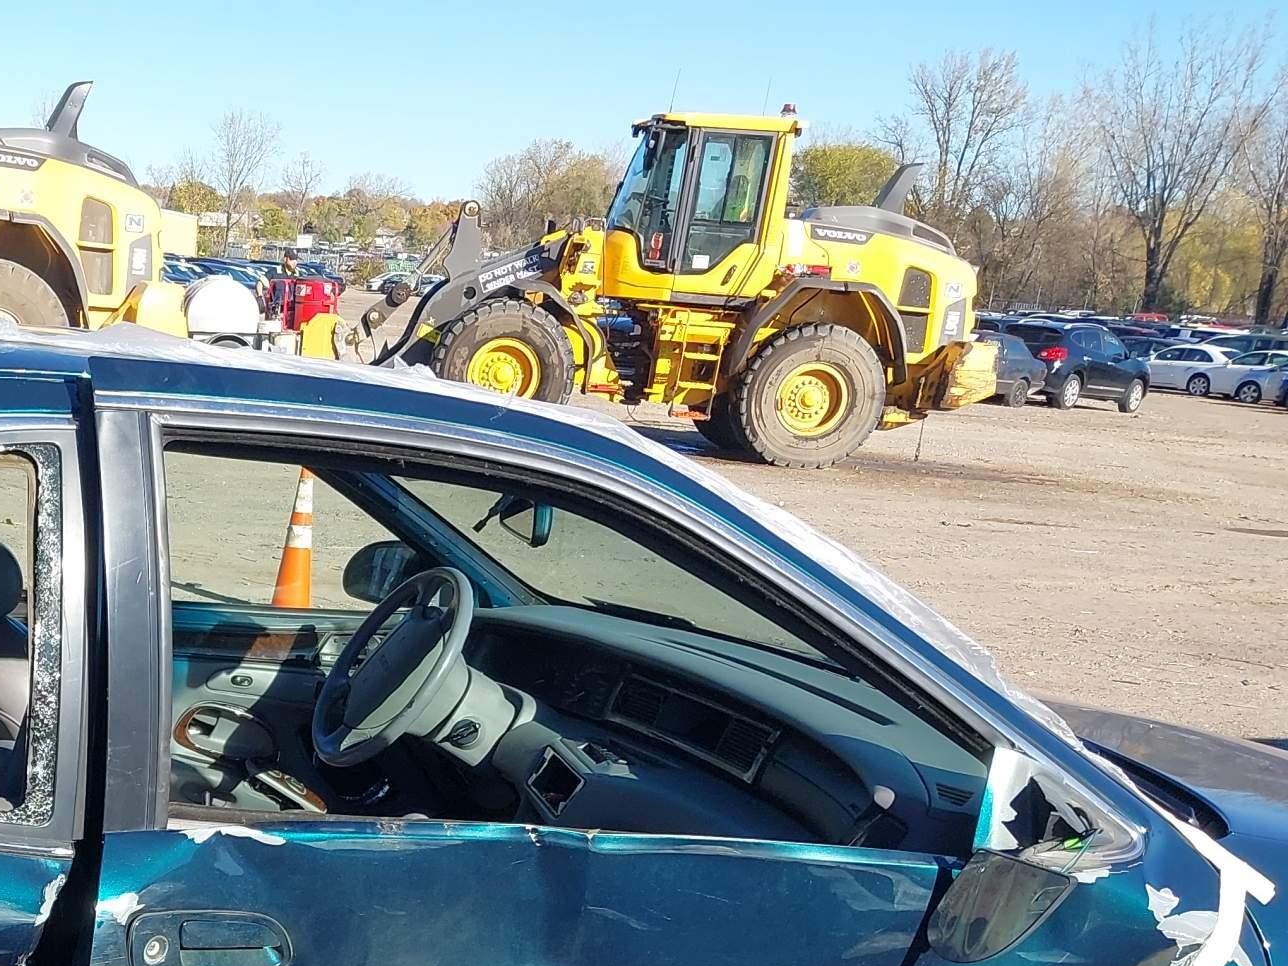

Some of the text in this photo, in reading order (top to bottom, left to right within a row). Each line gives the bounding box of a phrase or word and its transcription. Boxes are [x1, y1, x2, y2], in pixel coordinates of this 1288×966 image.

[815, 228, 867, 242] VOLVO
[479, 254, 540, 282] DO NOT WALK
[516, 264, 539, 280] MAST
